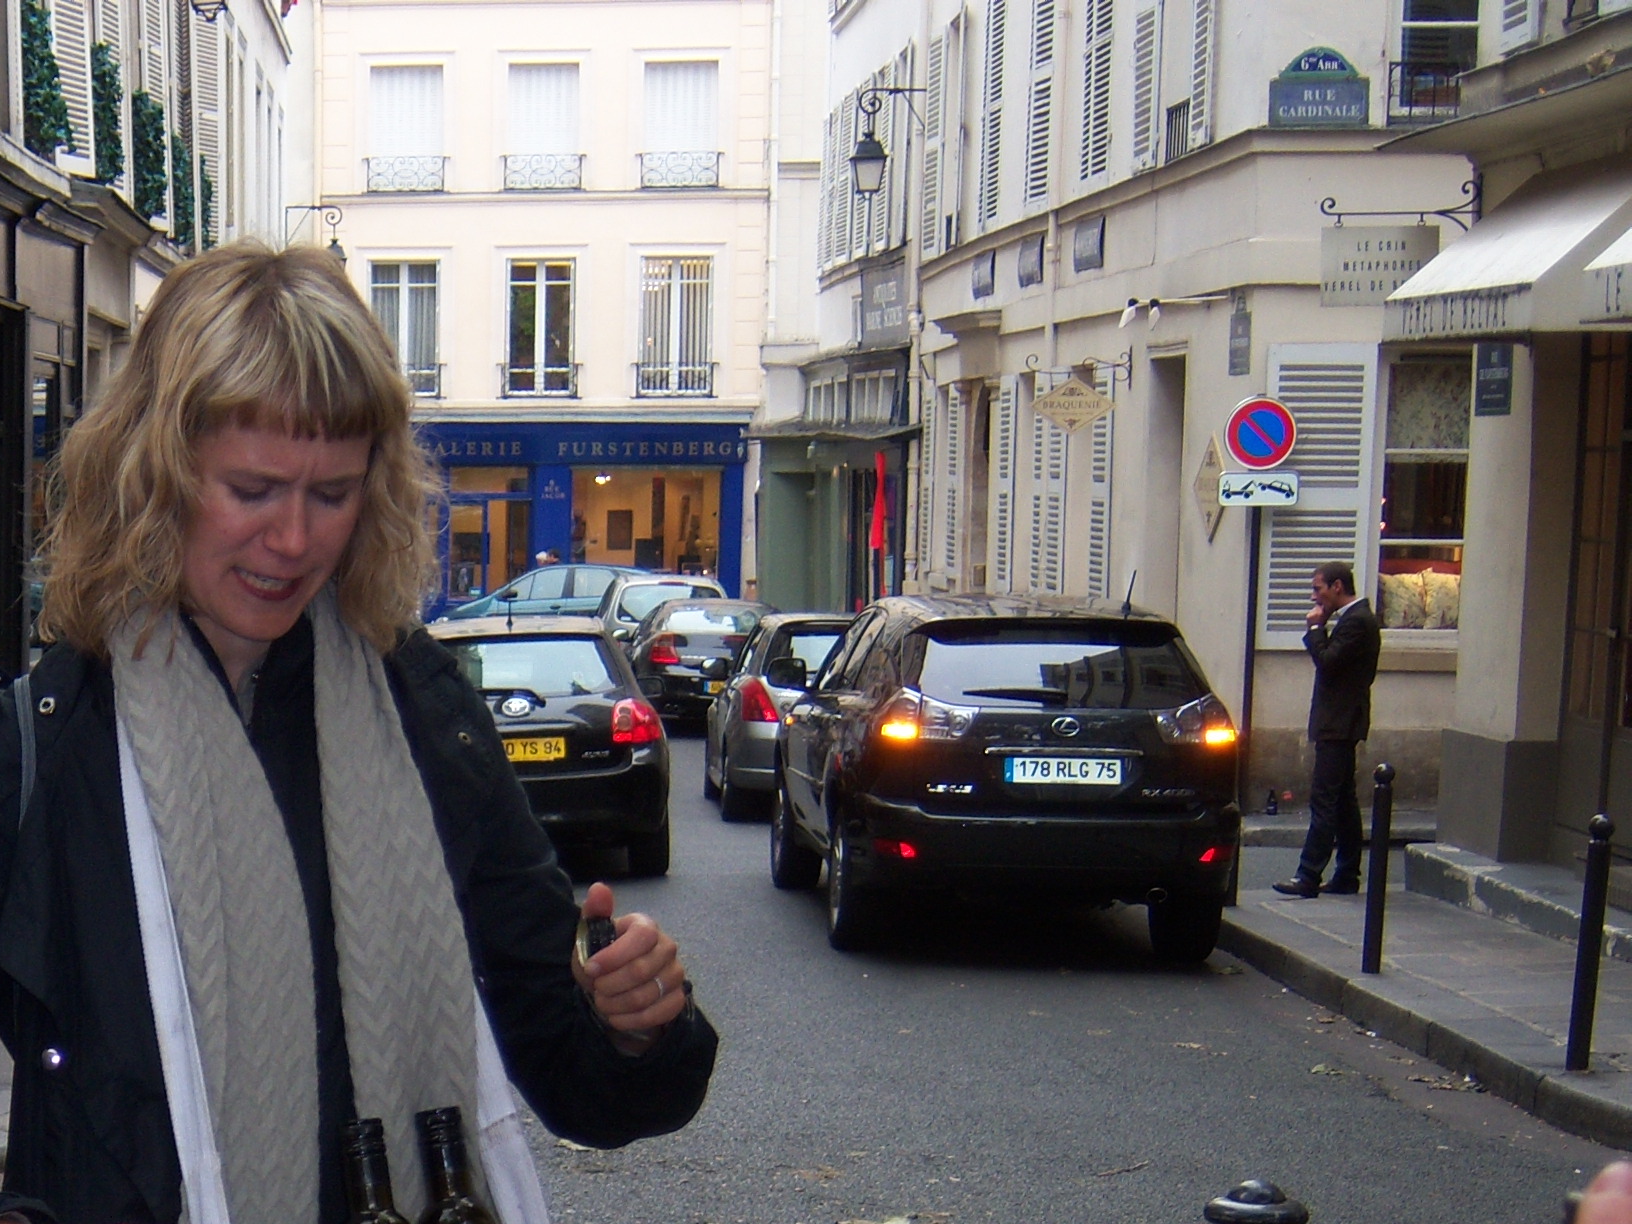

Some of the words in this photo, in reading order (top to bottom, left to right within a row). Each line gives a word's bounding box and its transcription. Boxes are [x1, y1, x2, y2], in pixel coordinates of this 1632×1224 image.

[1303, 89, 1337, 102] RUE
[1279, 103, 1361, 118] CARDINALE
[1357, 240, 1369, 252] LE
[1370, 280, 1383, 292] DE
[557, 440, 732, 457] FURSTENBERG
[520, 741, 538, 756] YS
[543, 740, 562, 755] 94
[1019, 760, 1051, 778] 178
[1056, 761, 1090, 779] RLG
[1095, 761, 1118, 779] 75
[926, 782, 974, 794] LEXUS
